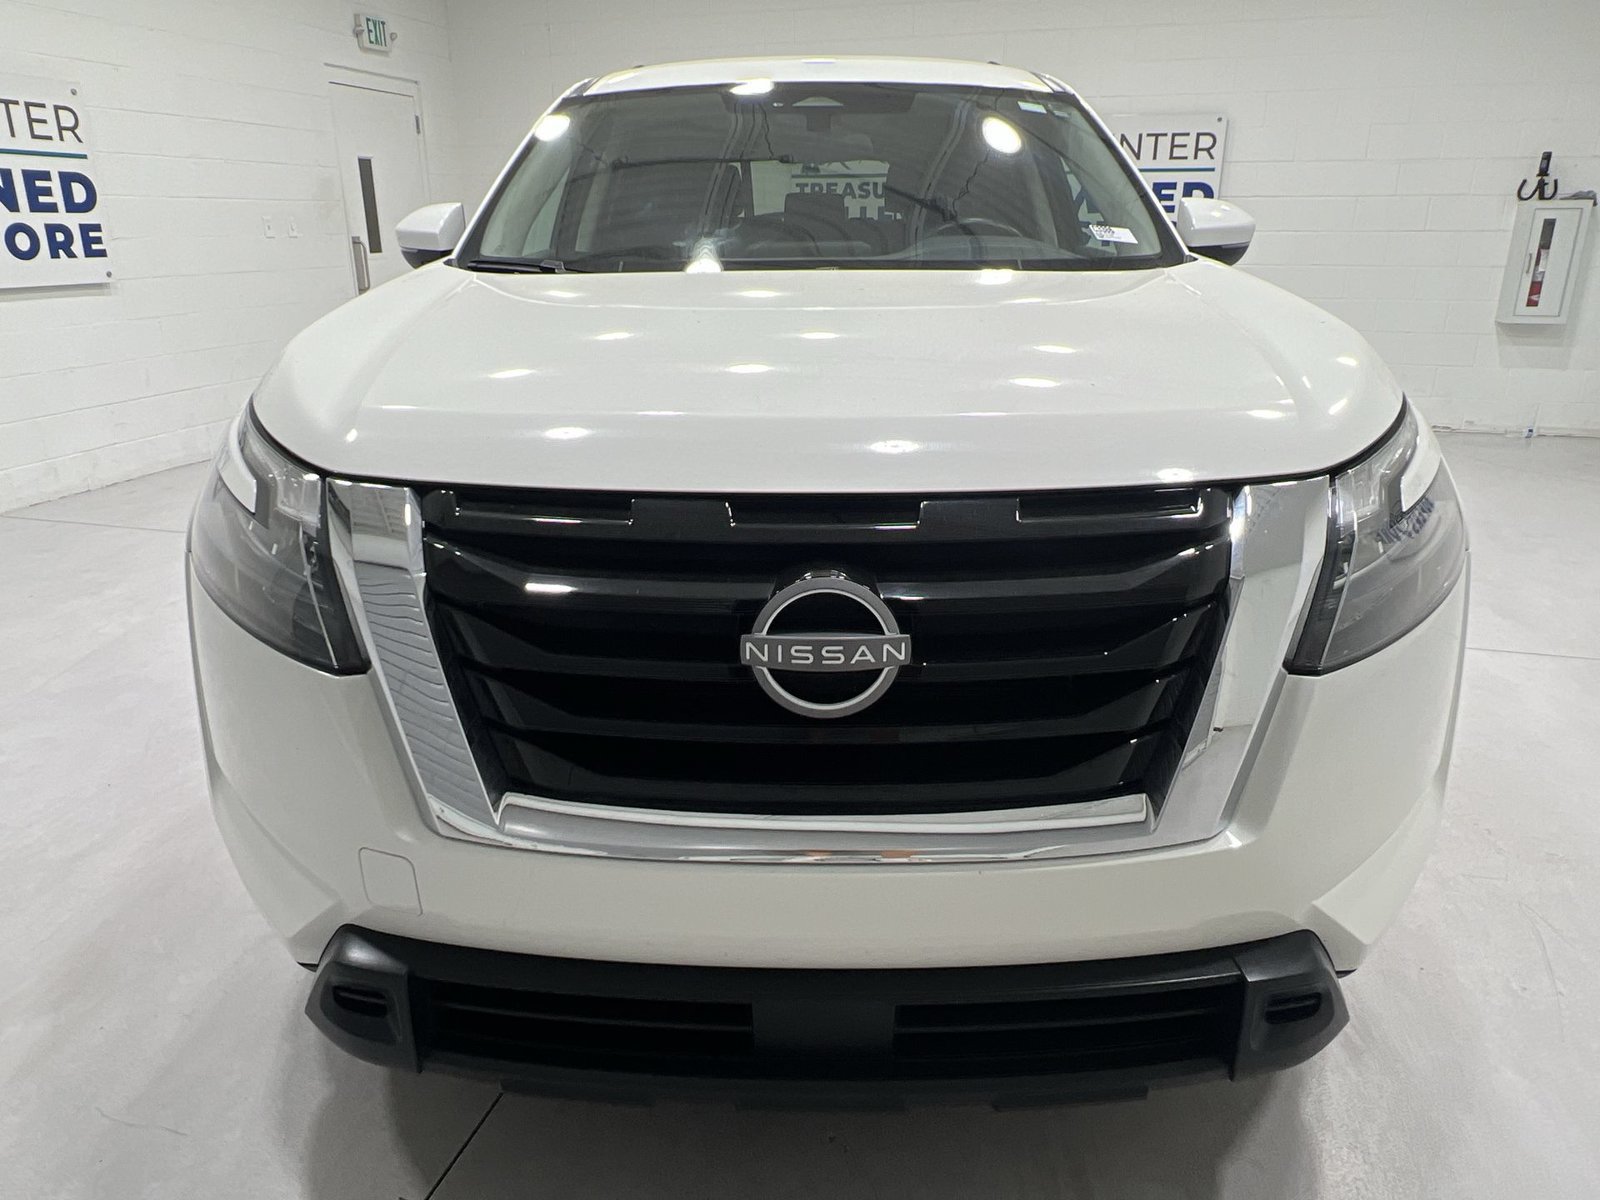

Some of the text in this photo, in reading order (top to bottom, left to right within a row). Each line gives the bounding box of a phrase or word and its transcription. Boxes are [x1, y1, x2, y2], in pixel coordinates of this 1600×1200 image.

[366, 17, 387, 47] EXIT
[0, 98, 84, 144] TER
[745, 641, 906, 665] NISSAN
